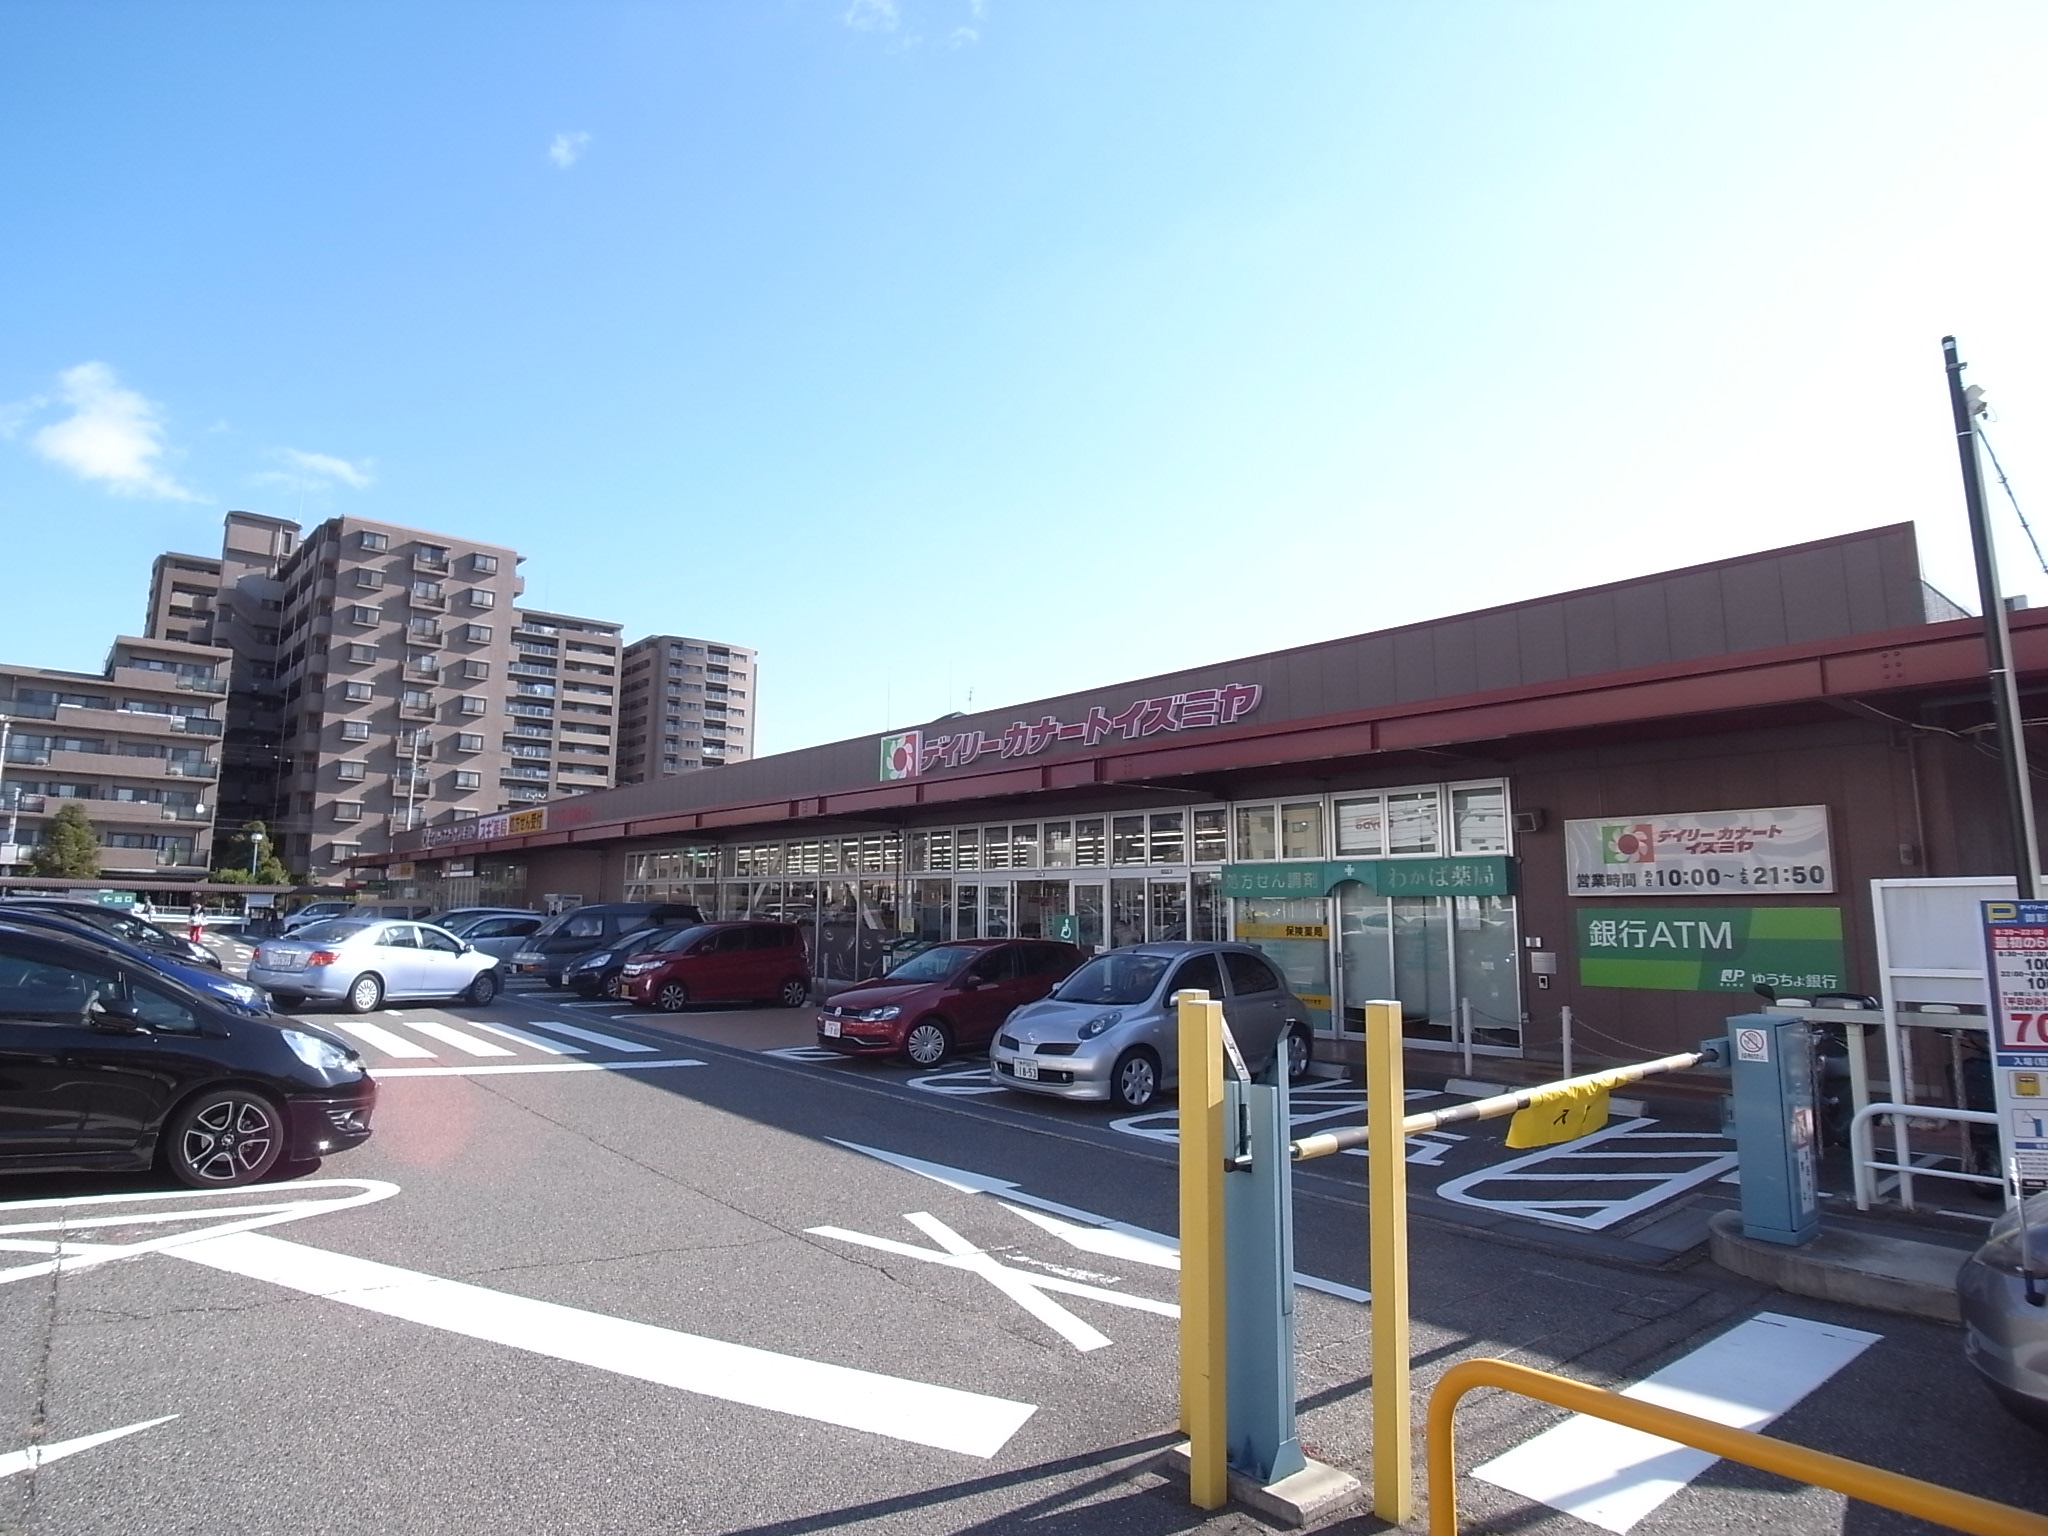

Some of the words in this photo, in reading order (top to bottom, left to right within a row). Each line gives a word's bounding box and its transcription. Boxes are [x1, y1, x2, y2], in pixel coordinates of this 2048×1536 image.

[922, 683, 1263, 770] デイリーカナートイズミヤ
[1685, 840, 1754, 855] イズミヤ
[1226, 872, 1318, 890] 処方せん調剤
[1389, 865, 1494, 888] わかば薬局
[1577, 873, 1636, 889] 営業時間
[1754, 866, 1825, 886] 21:50
[1285, 925, 1323, 937] 保険薬局
[1589, 920, 1733, 949] 銀行ATM
[1752, 973, 1838, 989] ゆうちょ銀行
